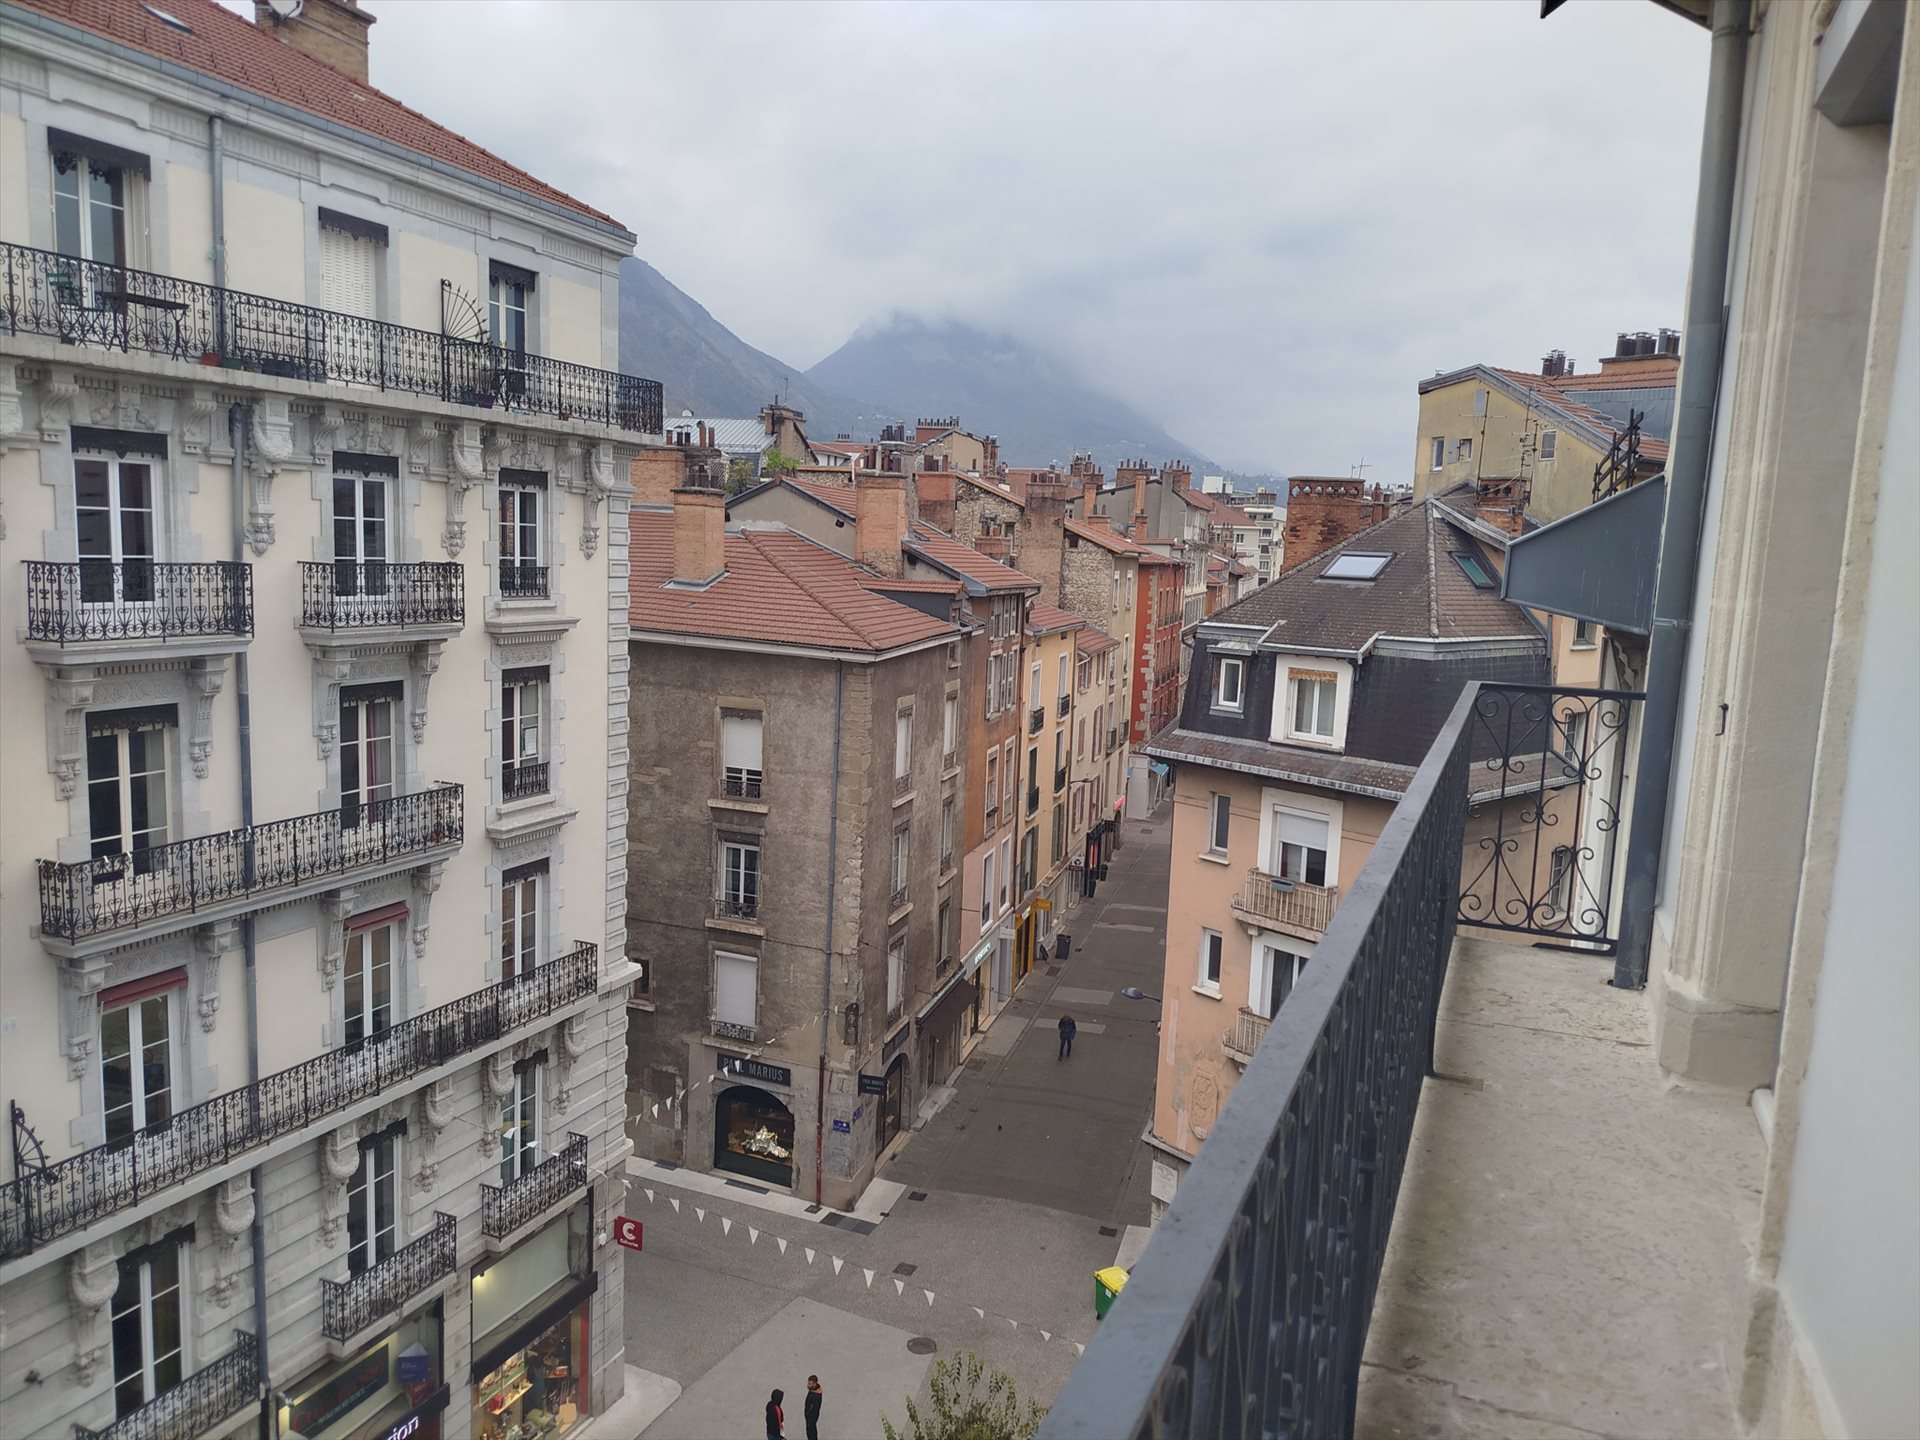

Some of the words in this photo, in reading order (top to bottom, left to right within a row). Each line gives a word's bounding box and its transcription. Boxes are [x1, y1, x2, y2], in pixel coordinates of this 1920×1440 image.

[723, 1057, 744, 1073] PAL
[749, 1062, 784, 1081] MARIUS
[622, 1222, 636, 1241] C
[387, 1416, 419, 1440] ion
